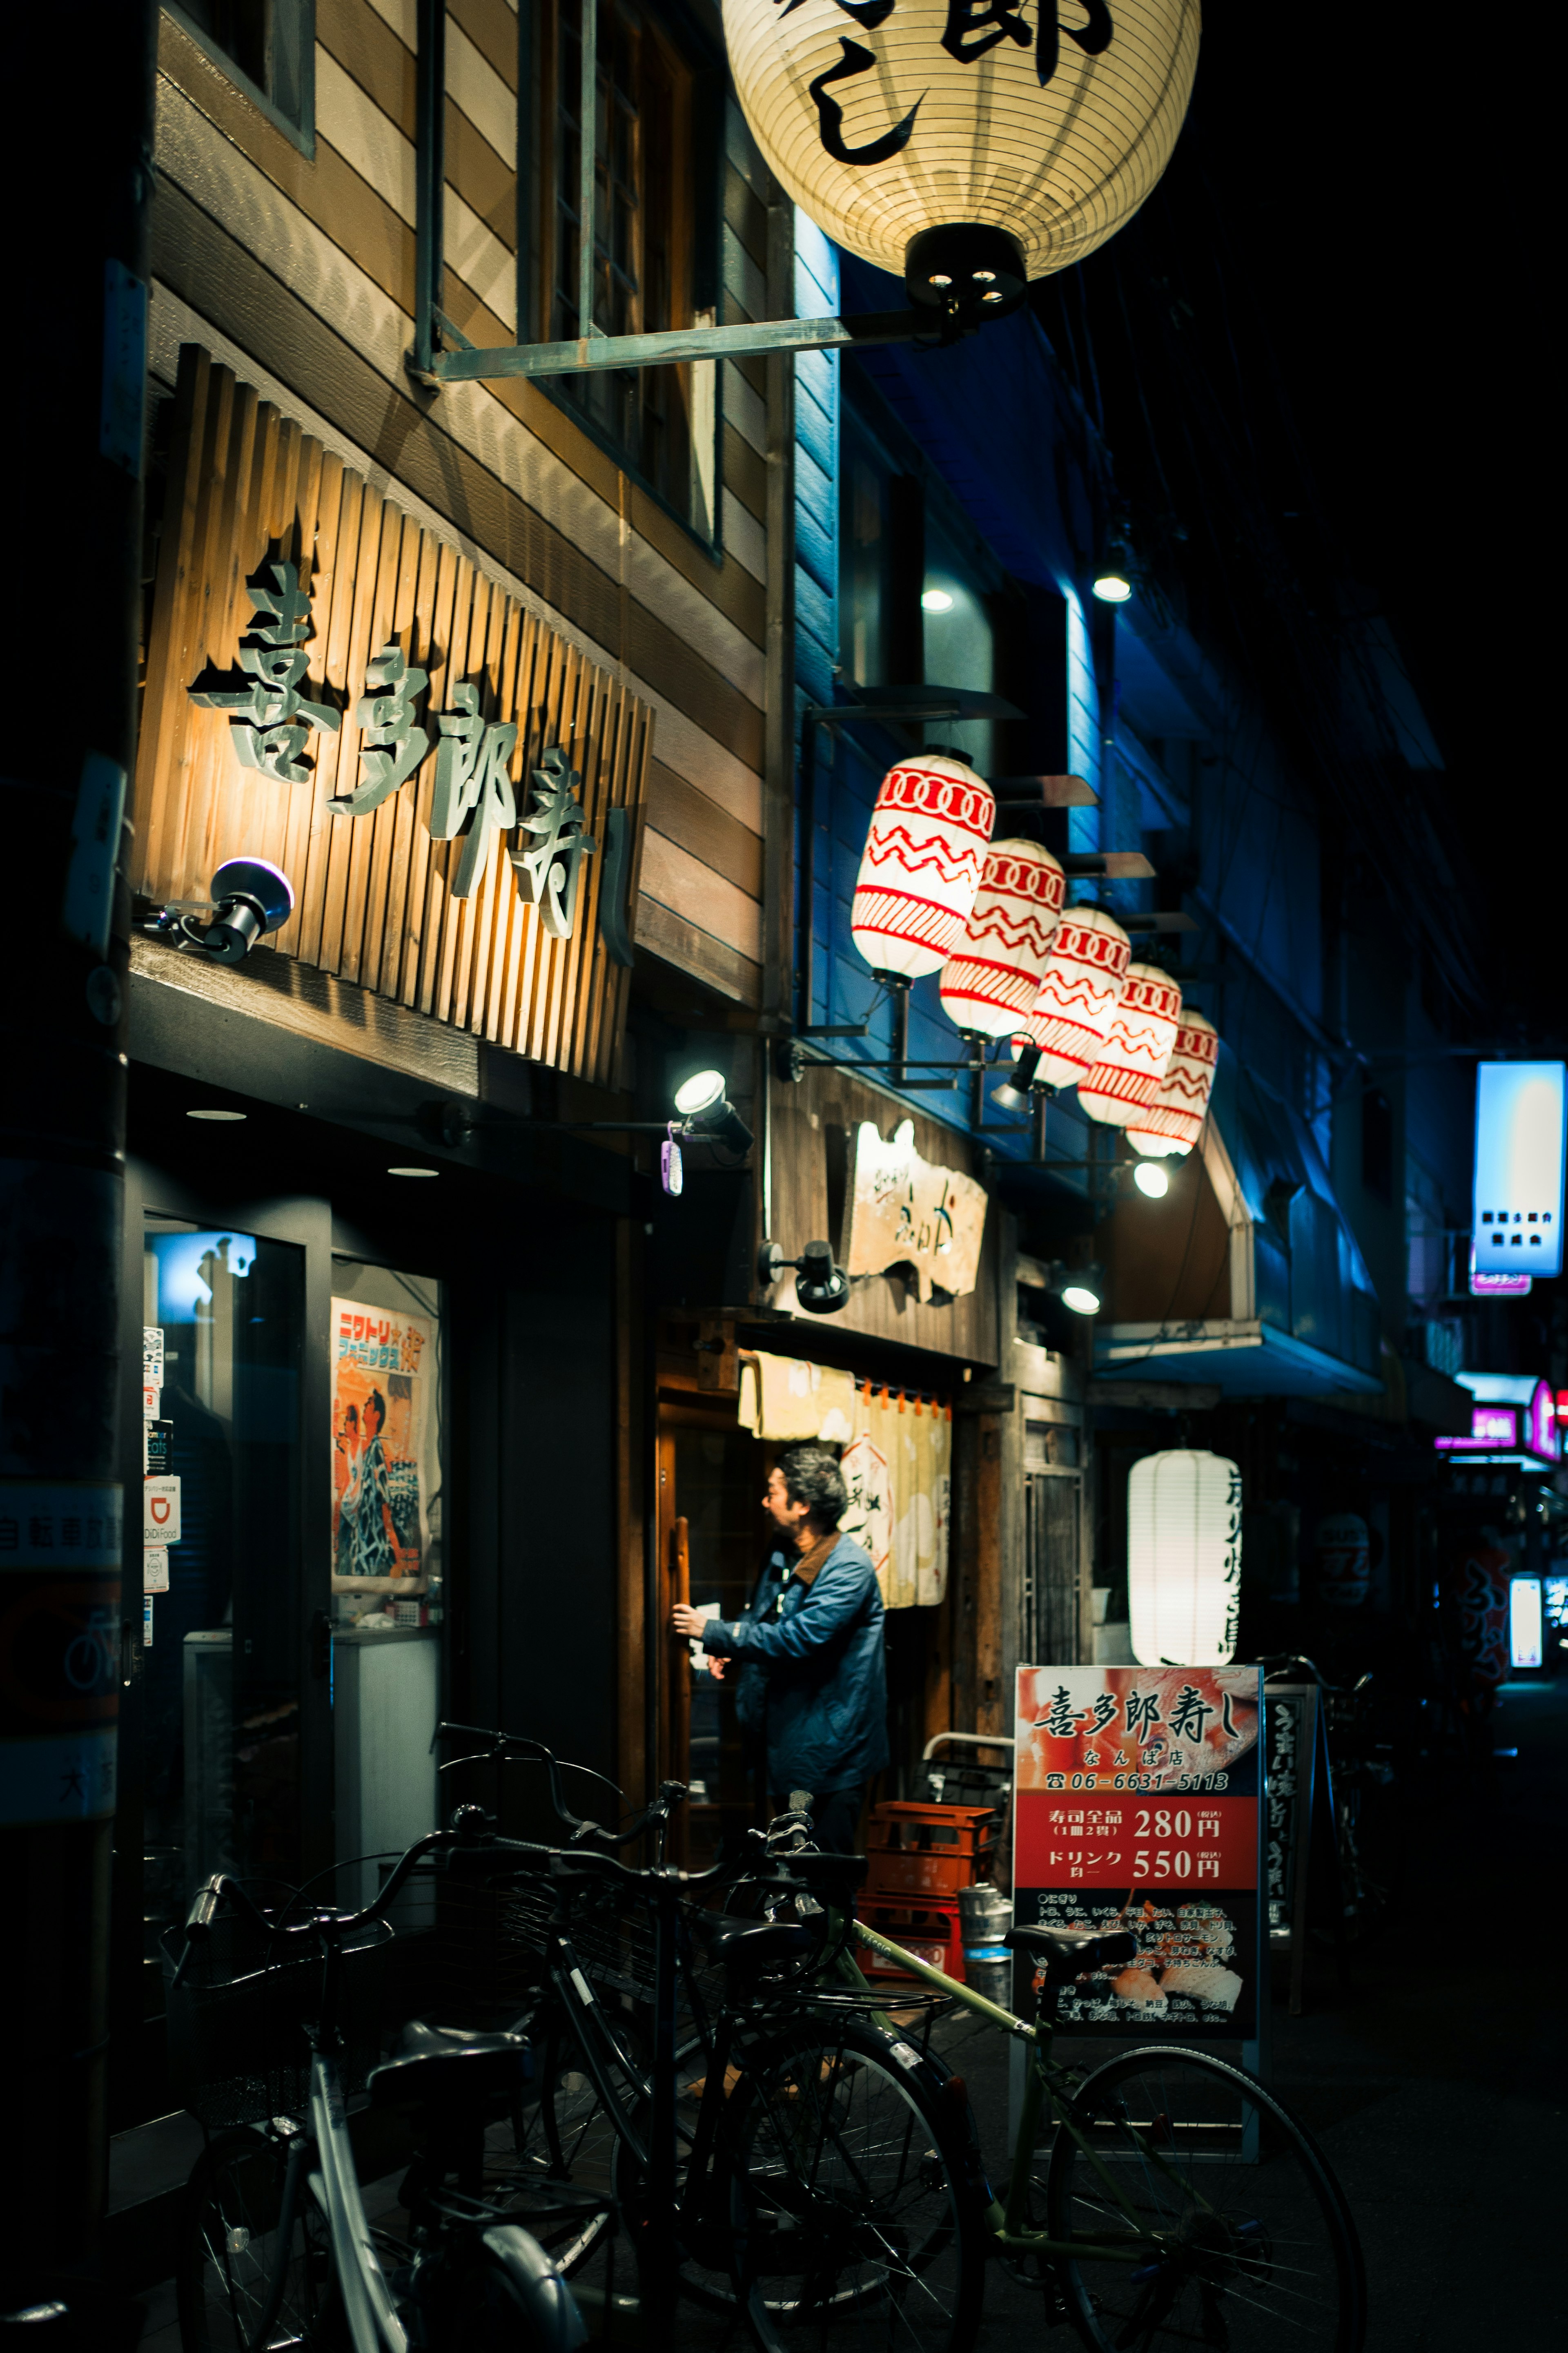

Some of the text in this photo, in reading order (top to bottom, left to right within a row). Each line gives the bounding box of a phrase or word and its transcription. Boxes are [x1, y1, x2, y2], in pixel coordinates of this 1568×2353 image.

[188, 560, 634, 967] 喜多郎寿し
[340, 1313, 390, 1345] ニワトリ
[1034, 1685, 1240, 1744] 喜多郎寿し
[1084, 1750, 1183, 1766] なんば店
[1048, 1810, 1123, 1824] 寿司全品
[1049, 1851, 1122, 1865] ドリンク
[1070, 1867, 1100, 1878] 均一
